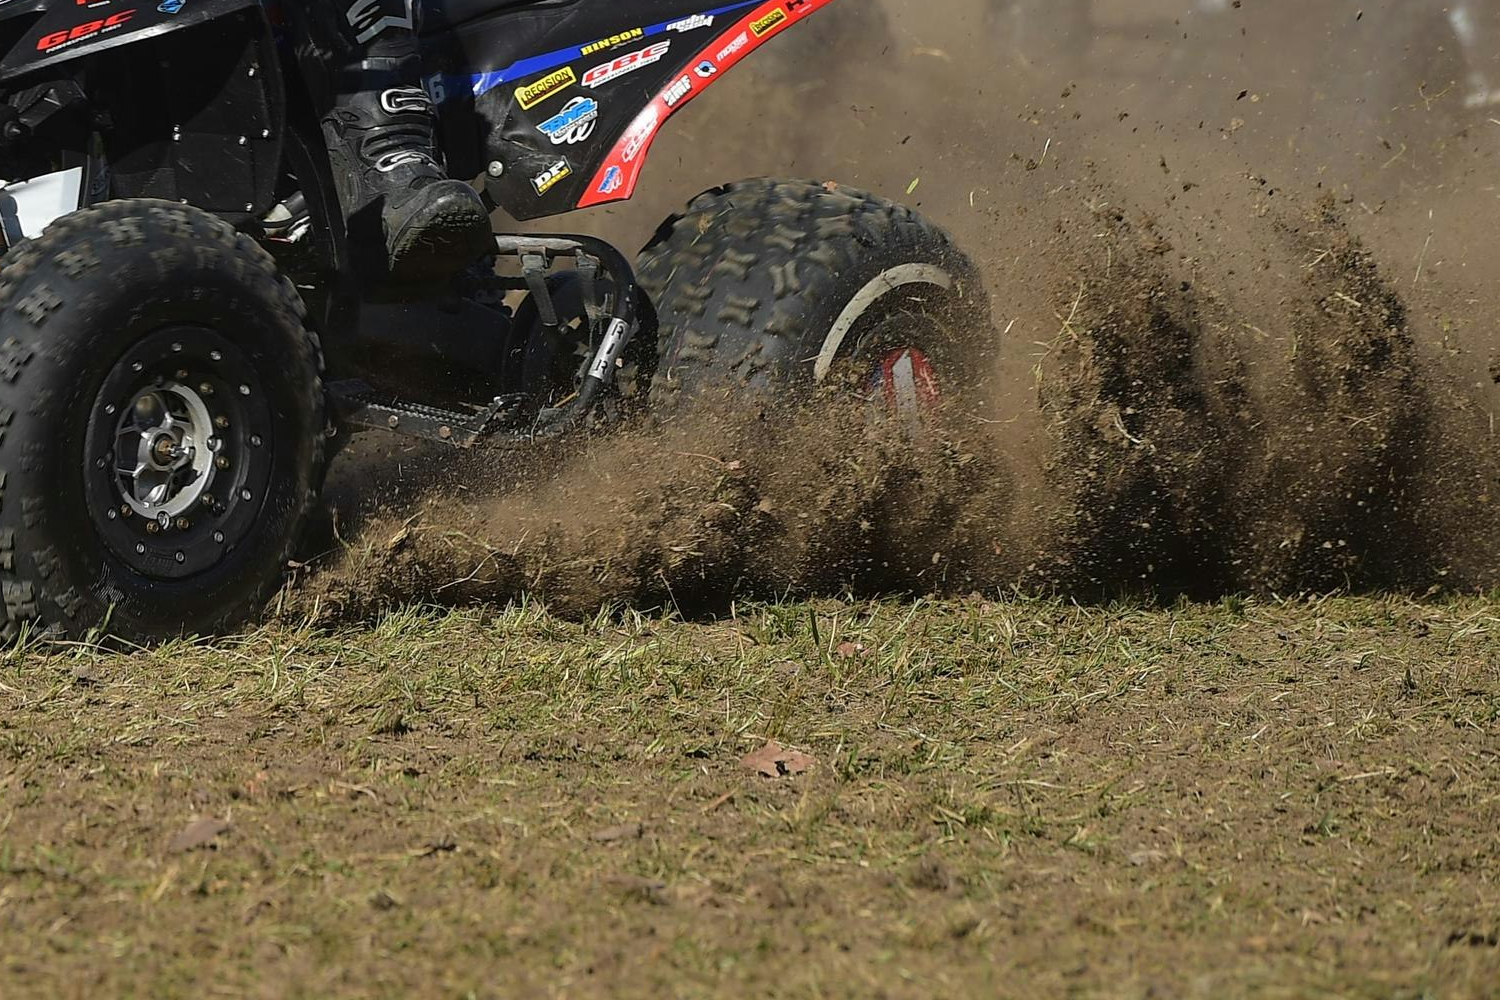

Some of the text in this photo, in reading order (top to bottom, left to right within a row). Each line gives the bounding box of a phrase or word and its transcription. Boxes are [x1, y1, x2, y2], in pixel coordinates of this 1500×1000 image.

[36, 8, 137, 50] GBC
[580, 27, 643, 56] HINSON
[584, 42, 669, 83] GBC
